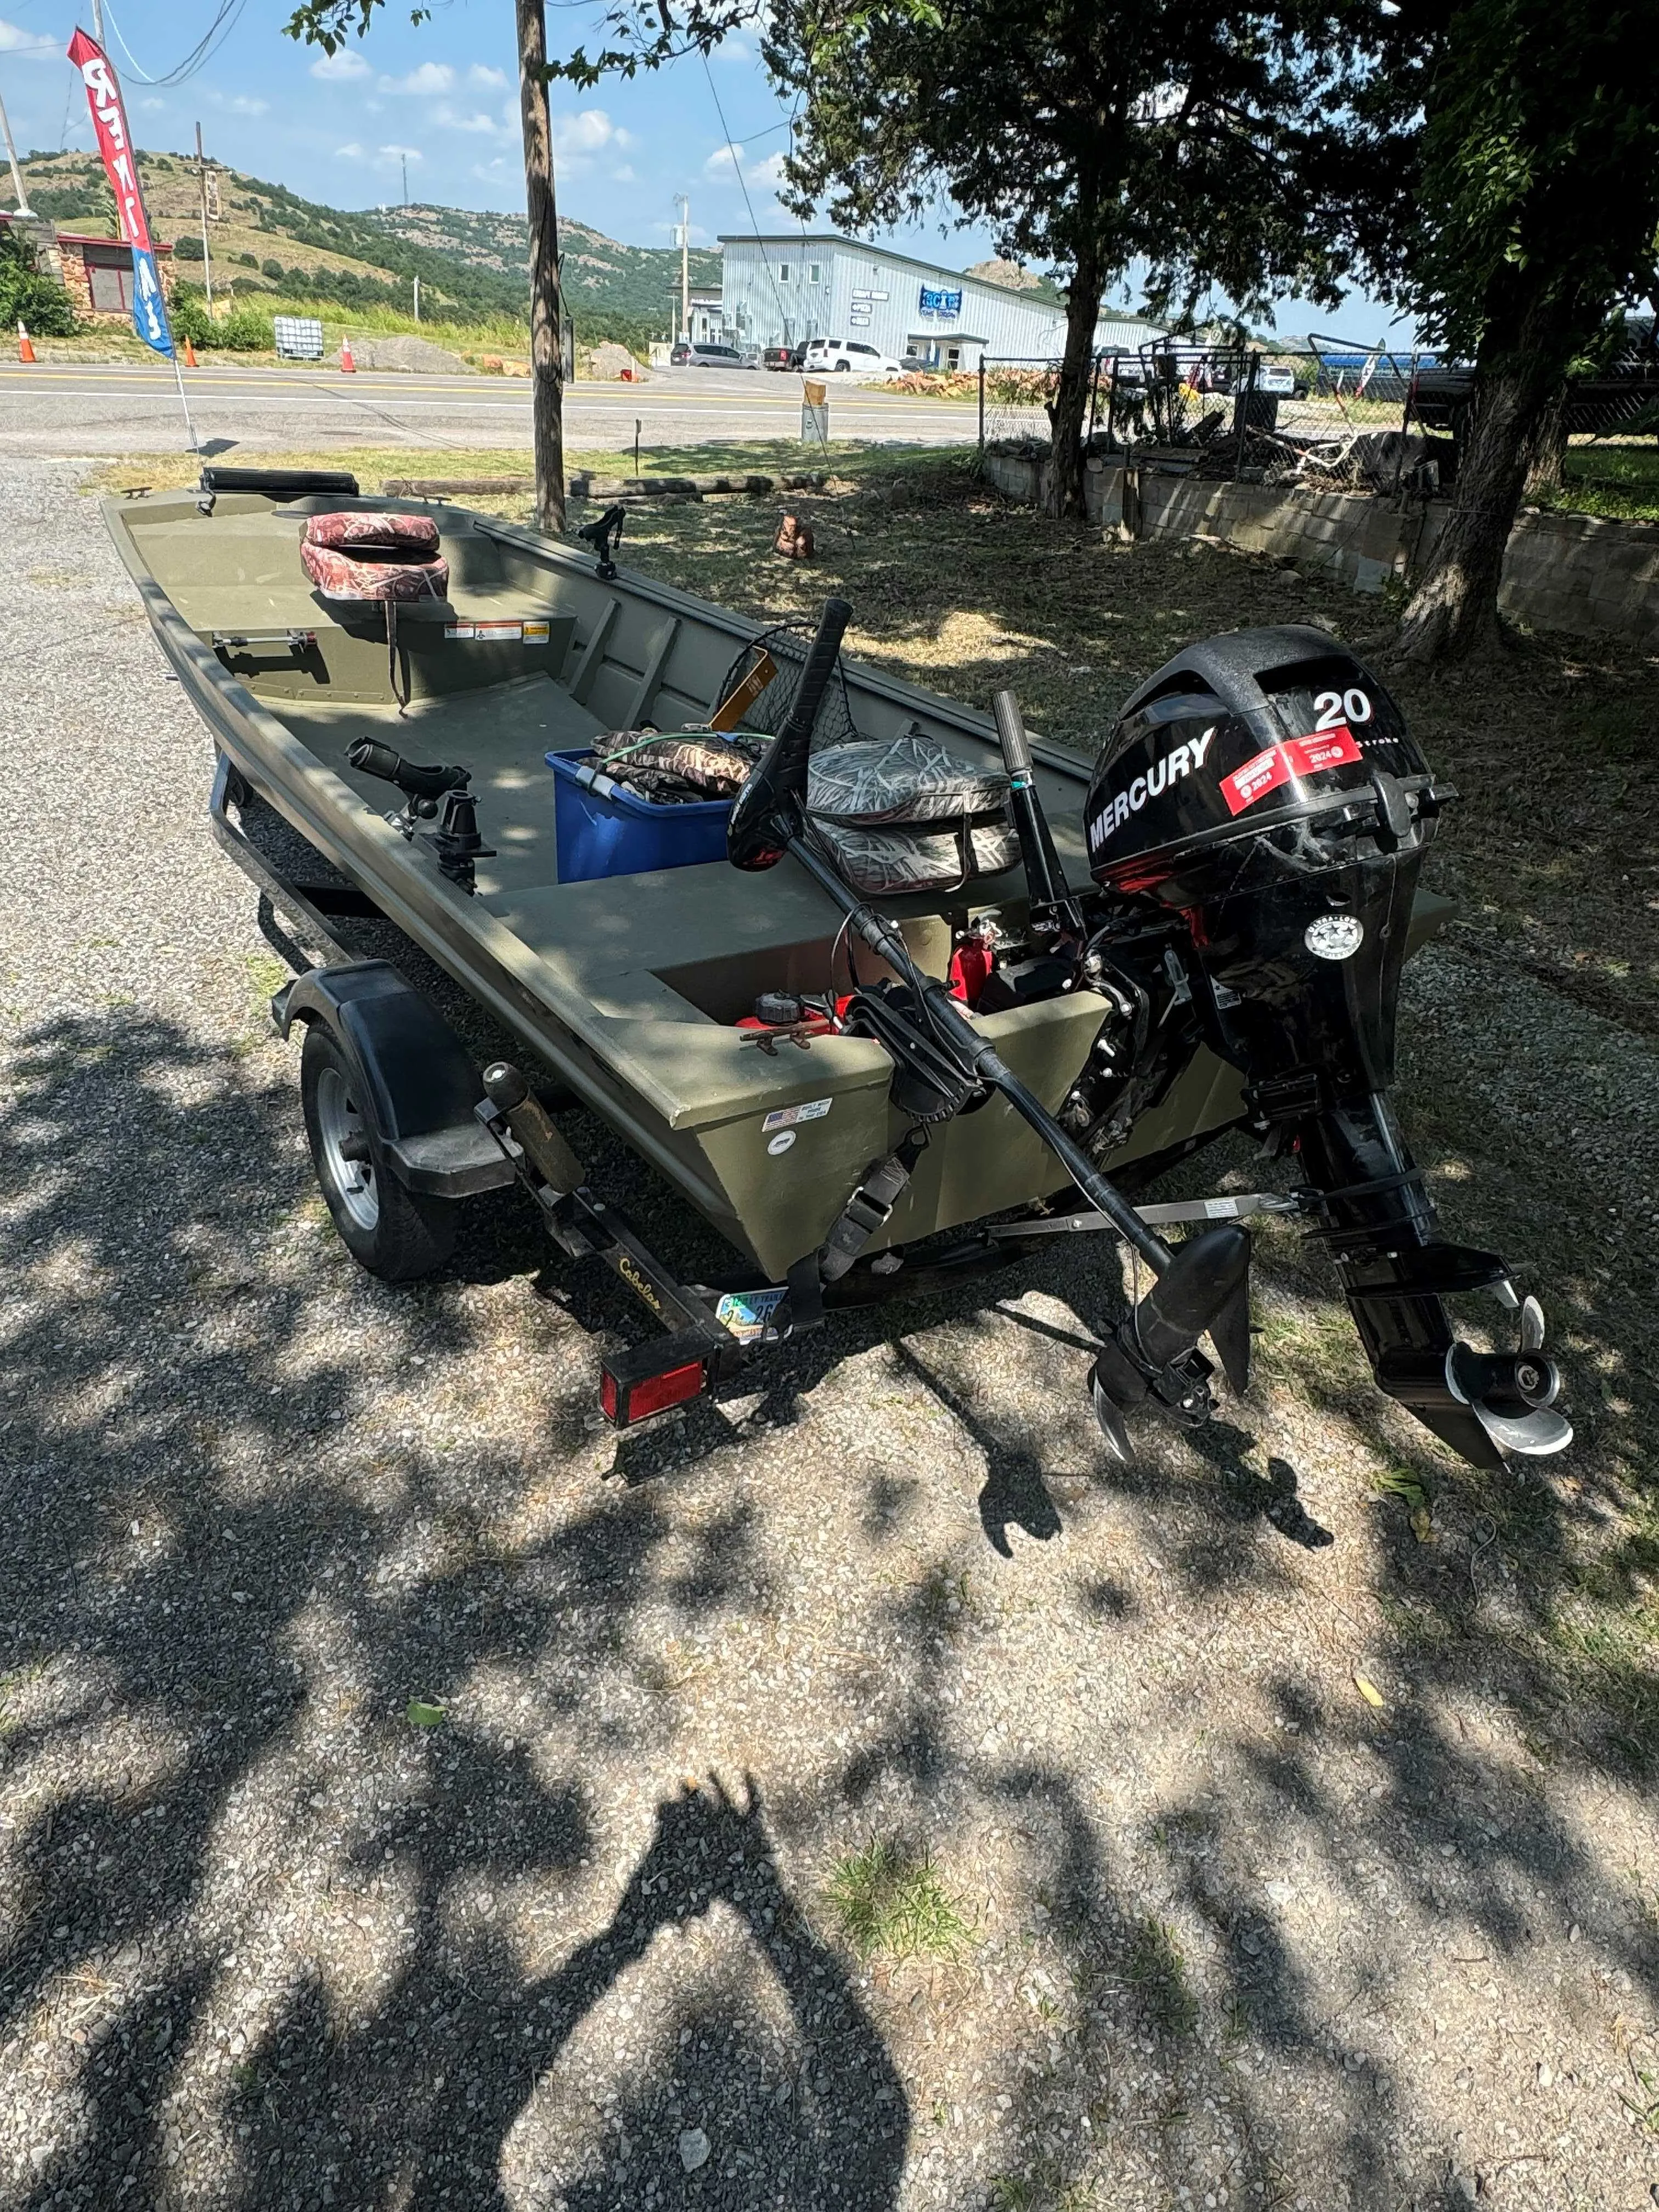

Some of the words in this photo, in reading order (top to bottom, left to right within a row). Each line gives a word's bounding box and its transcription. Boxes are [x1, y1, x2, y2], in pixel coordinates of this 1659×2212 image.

[1314, 688, 1372, 732] 20
[1309, 751, 1332, 764] 2024
[1090, 726, 1217, 853] MERCURY
[1251, 772, 1273, 792] 2024
